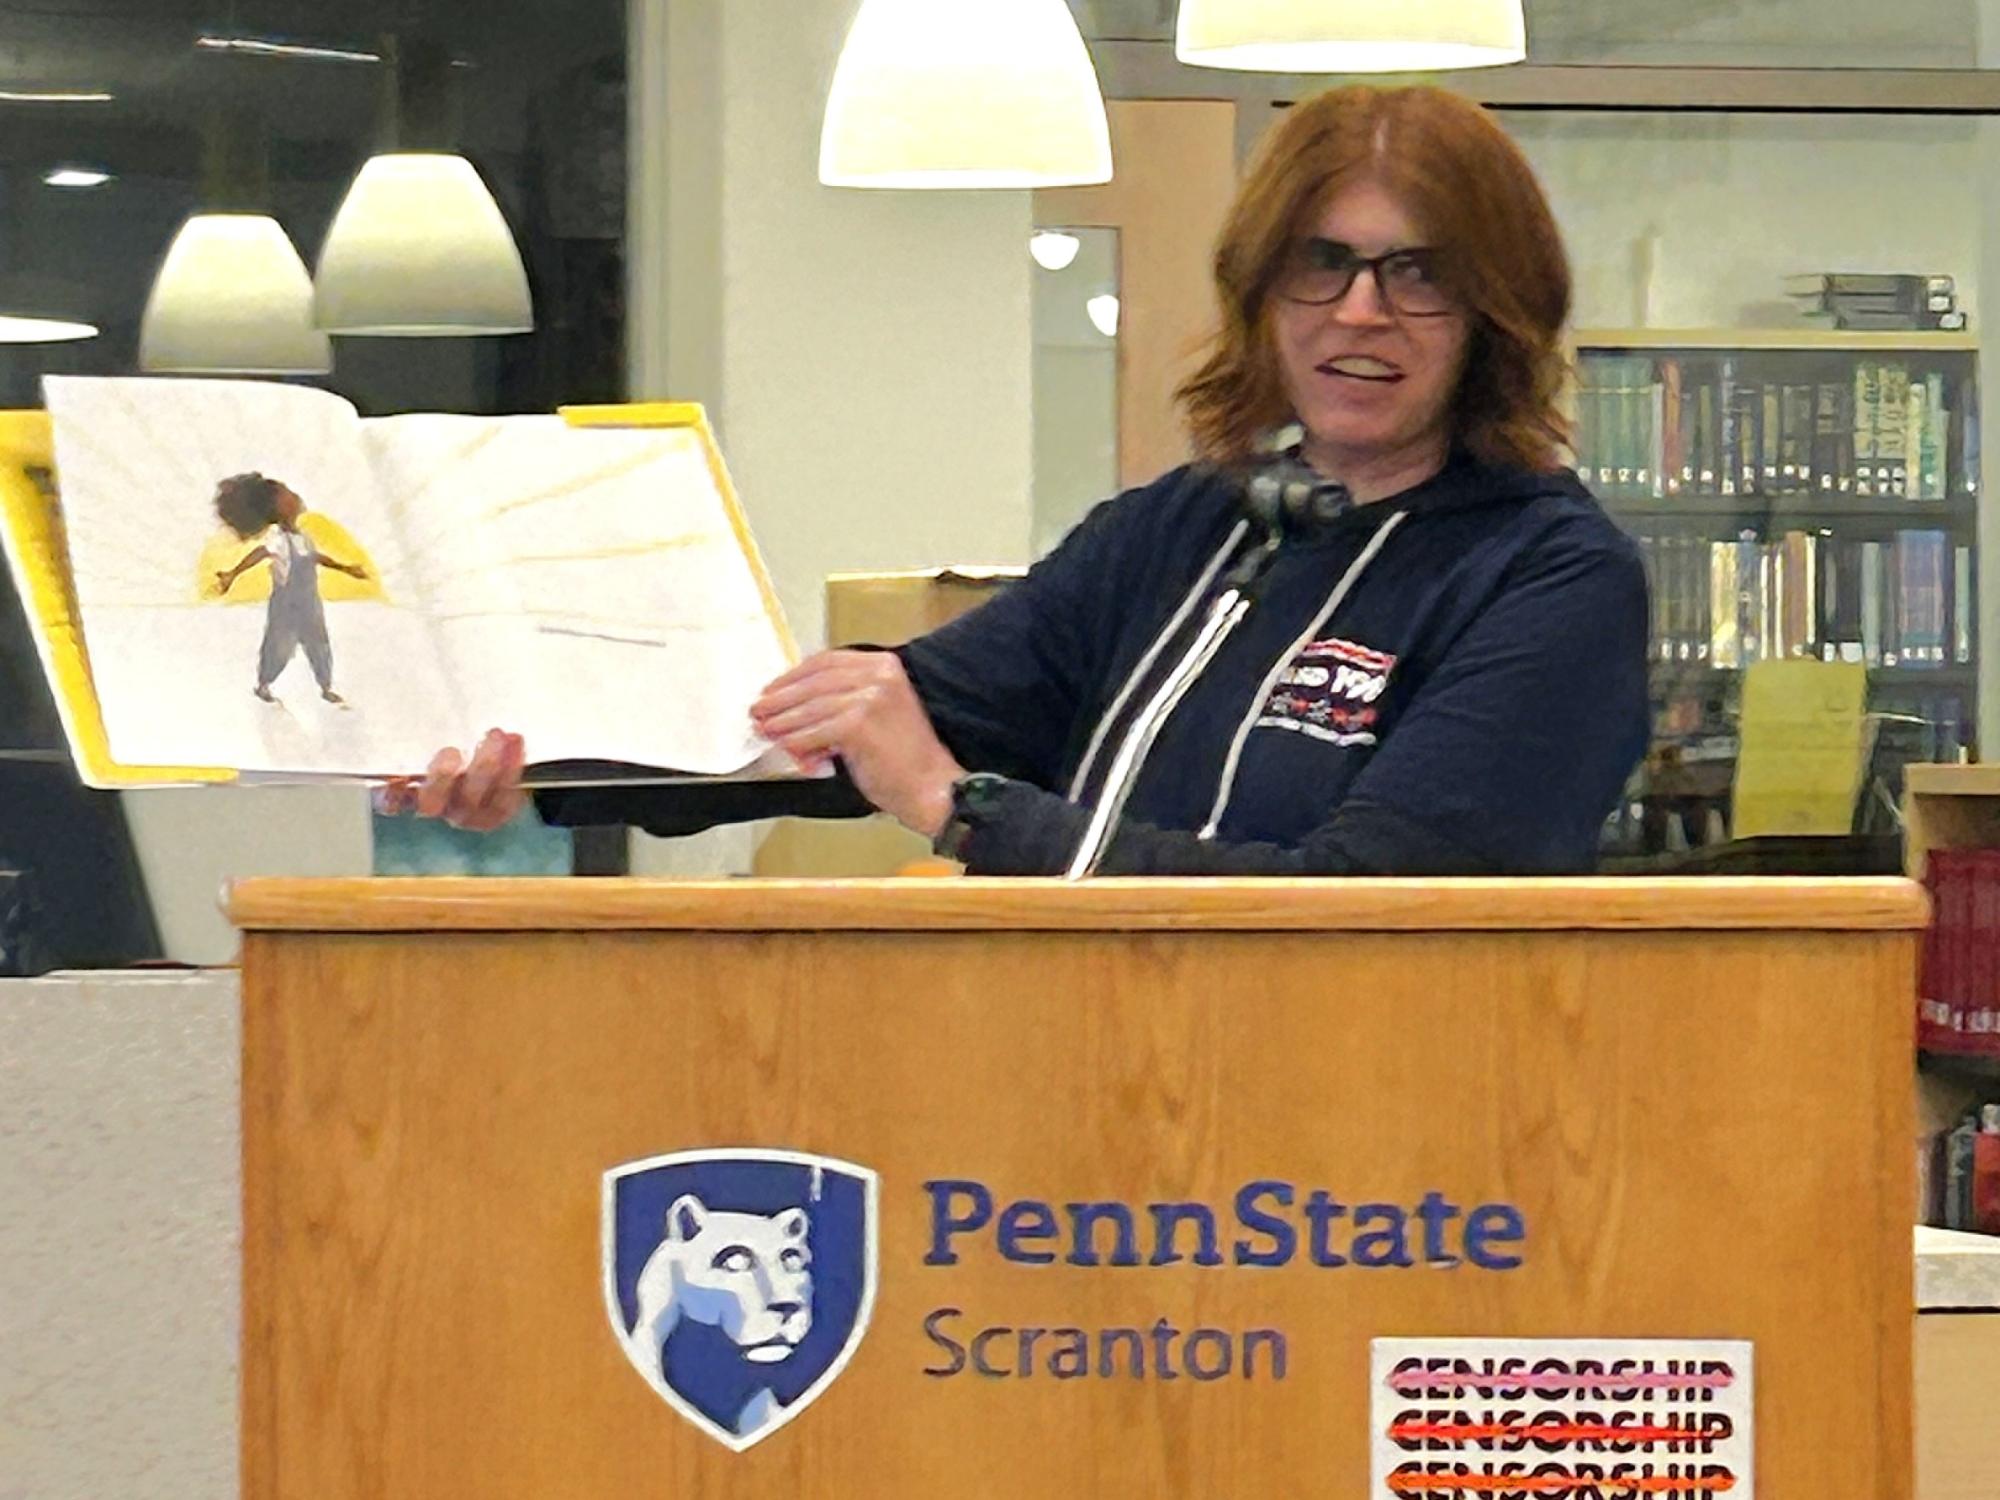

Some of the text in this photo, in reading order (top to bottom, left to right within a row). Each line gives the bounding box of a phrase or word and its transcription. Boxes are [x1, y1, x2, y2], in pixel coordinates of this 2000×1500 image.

[923, 1308, 1287, 1379] Scranton
[1391, 1357, 1733, 1401] CENSORSHIP
[1390, 1409, 1733, 1454] CENSORSHIP
